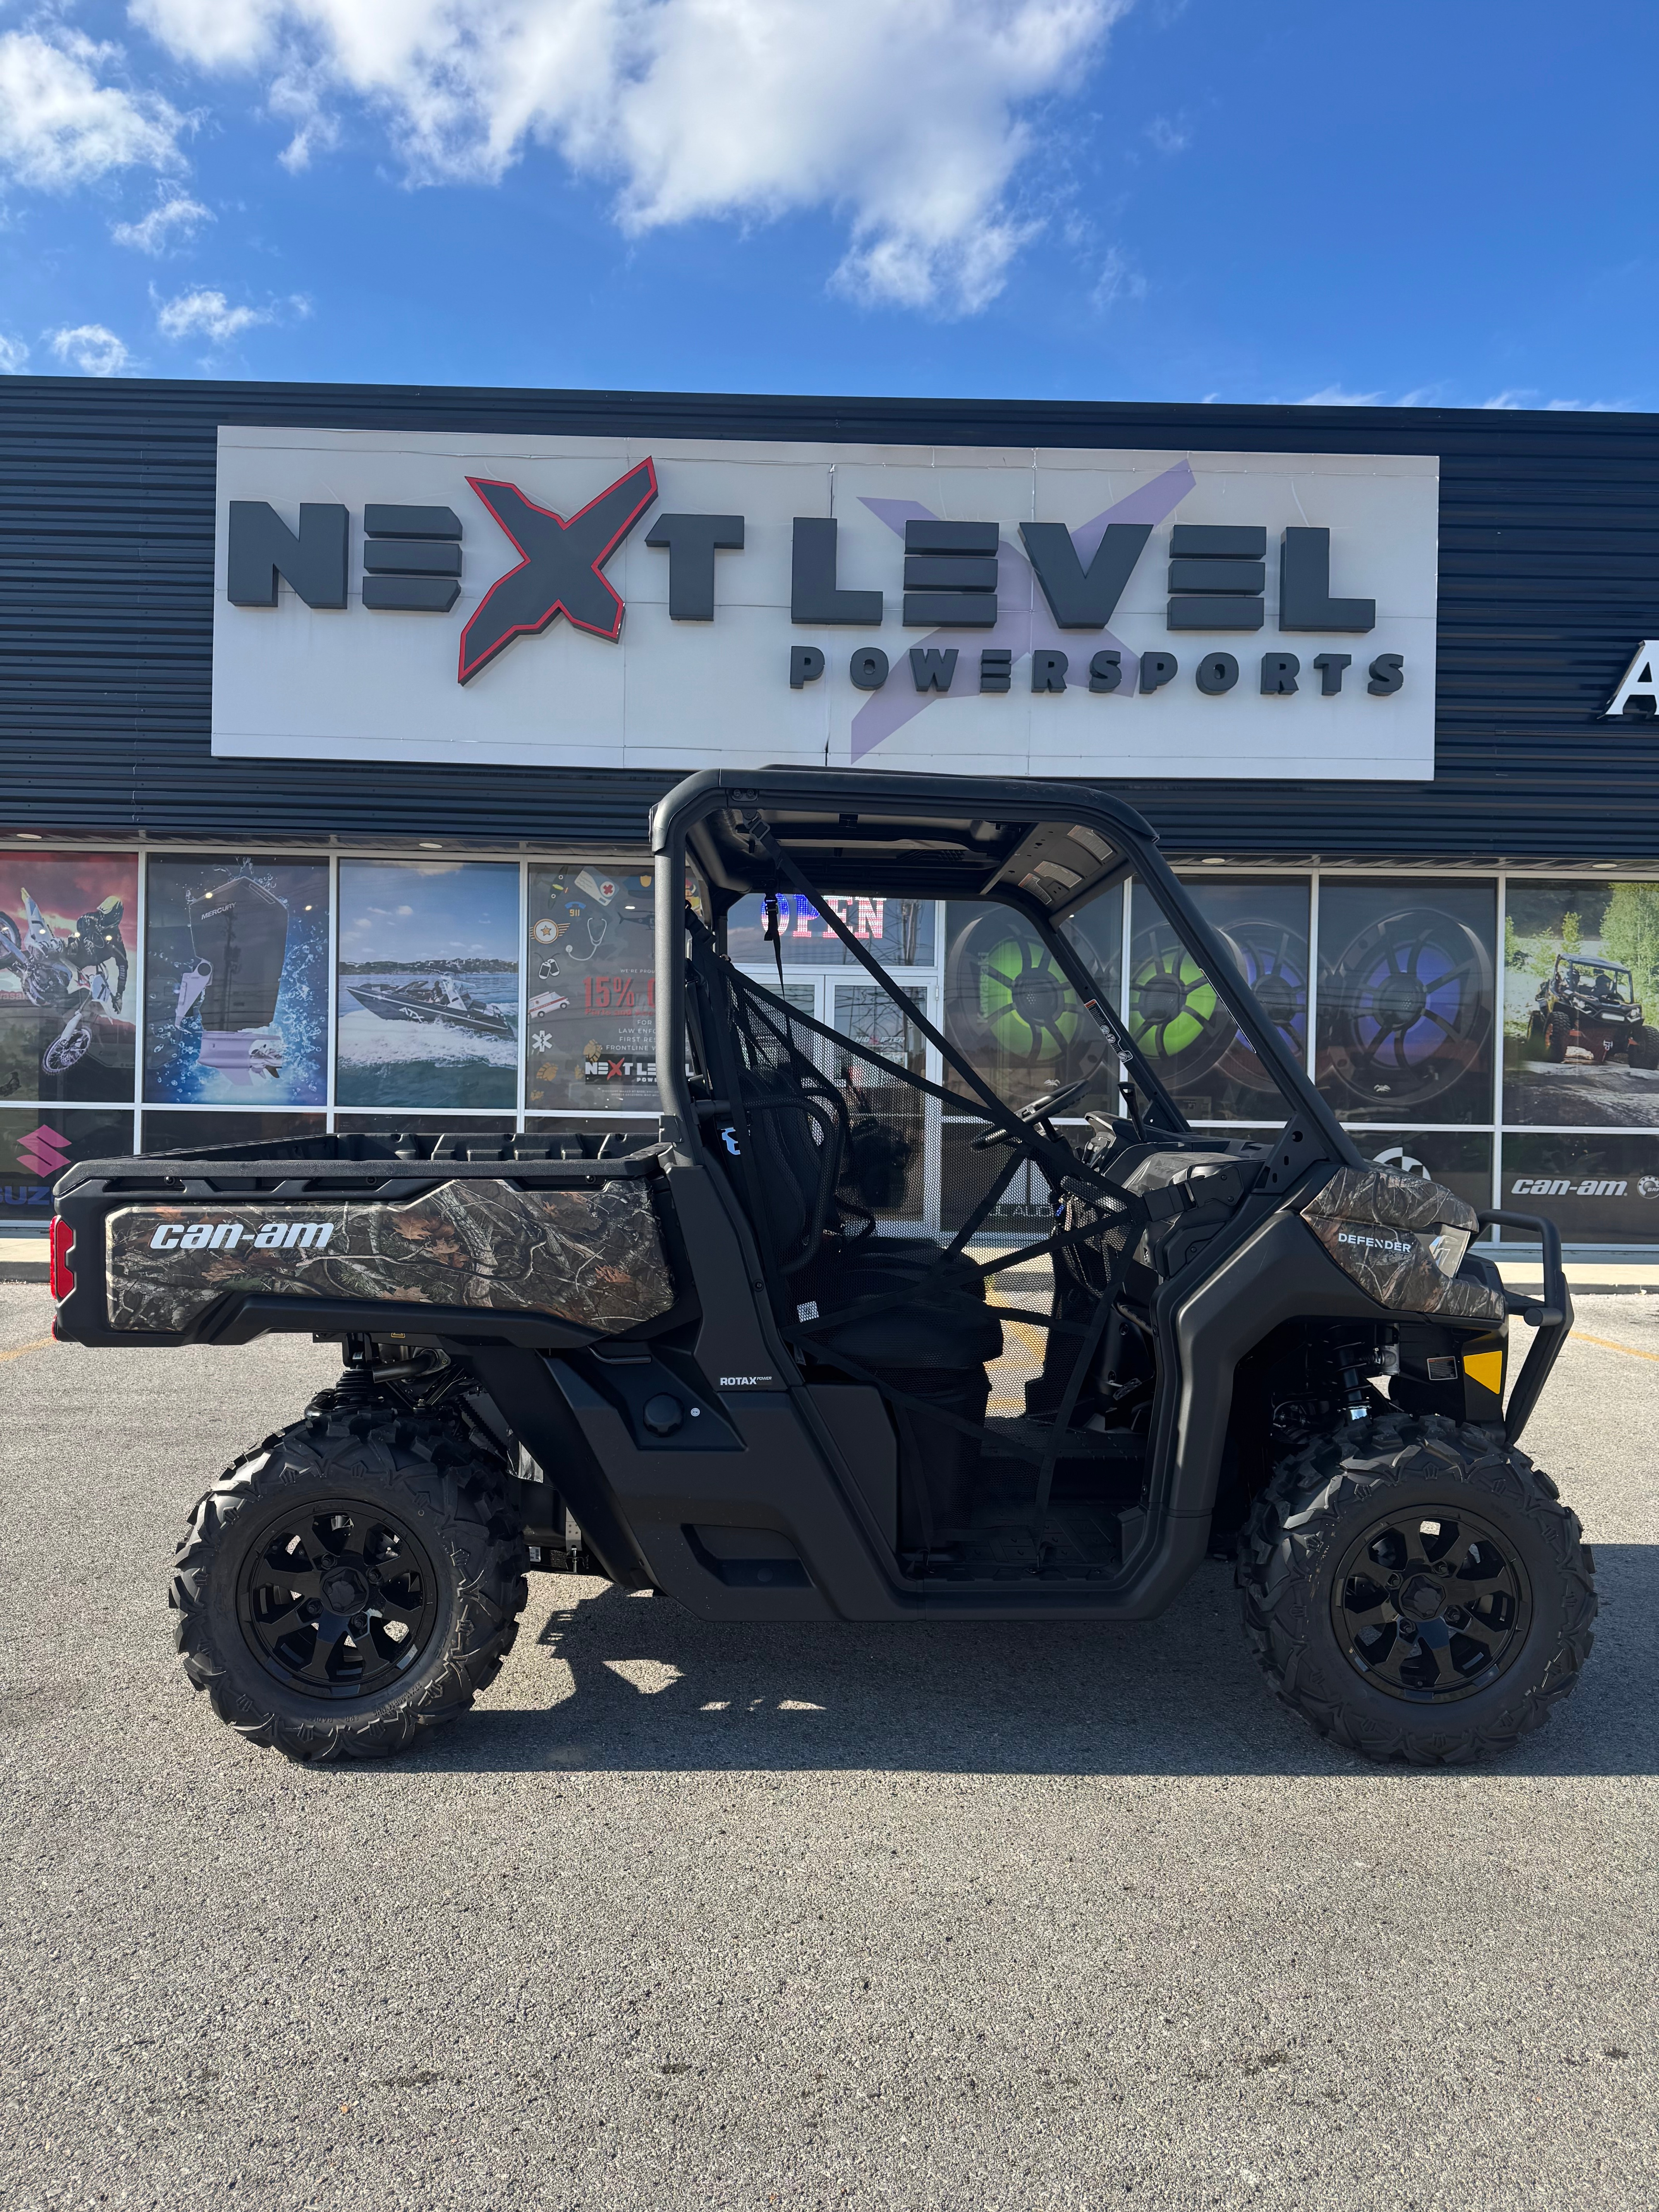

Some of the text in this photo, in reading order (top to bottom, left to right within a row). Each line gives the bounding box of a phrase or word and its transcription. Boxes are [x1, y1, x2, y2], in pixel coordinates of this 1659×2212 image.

[228, 455, 1376, 687] NEXT LEVEL
[790, 646, 1404, 696] POWERSPORTS
[201, 902, 236, 920] MERCURY
[761, 893, 887, 939] OPEN
[582, 976, 635, 1008] 15%
[977, 952, 989, 1023] Kawasaki
[398, 1007, 425, 1023] ATX
[585, 1057, 634, 1080] NEXT
[1511, 1179, 1627, 1196] can-am
[1013, 1205, 1054, 1217] AUD
[150, 1223, 334, 1249] can-am
[1338, 1233, 1411, 1253] DEFENDER
[720, 1377, 757, 1385] ROTAX
